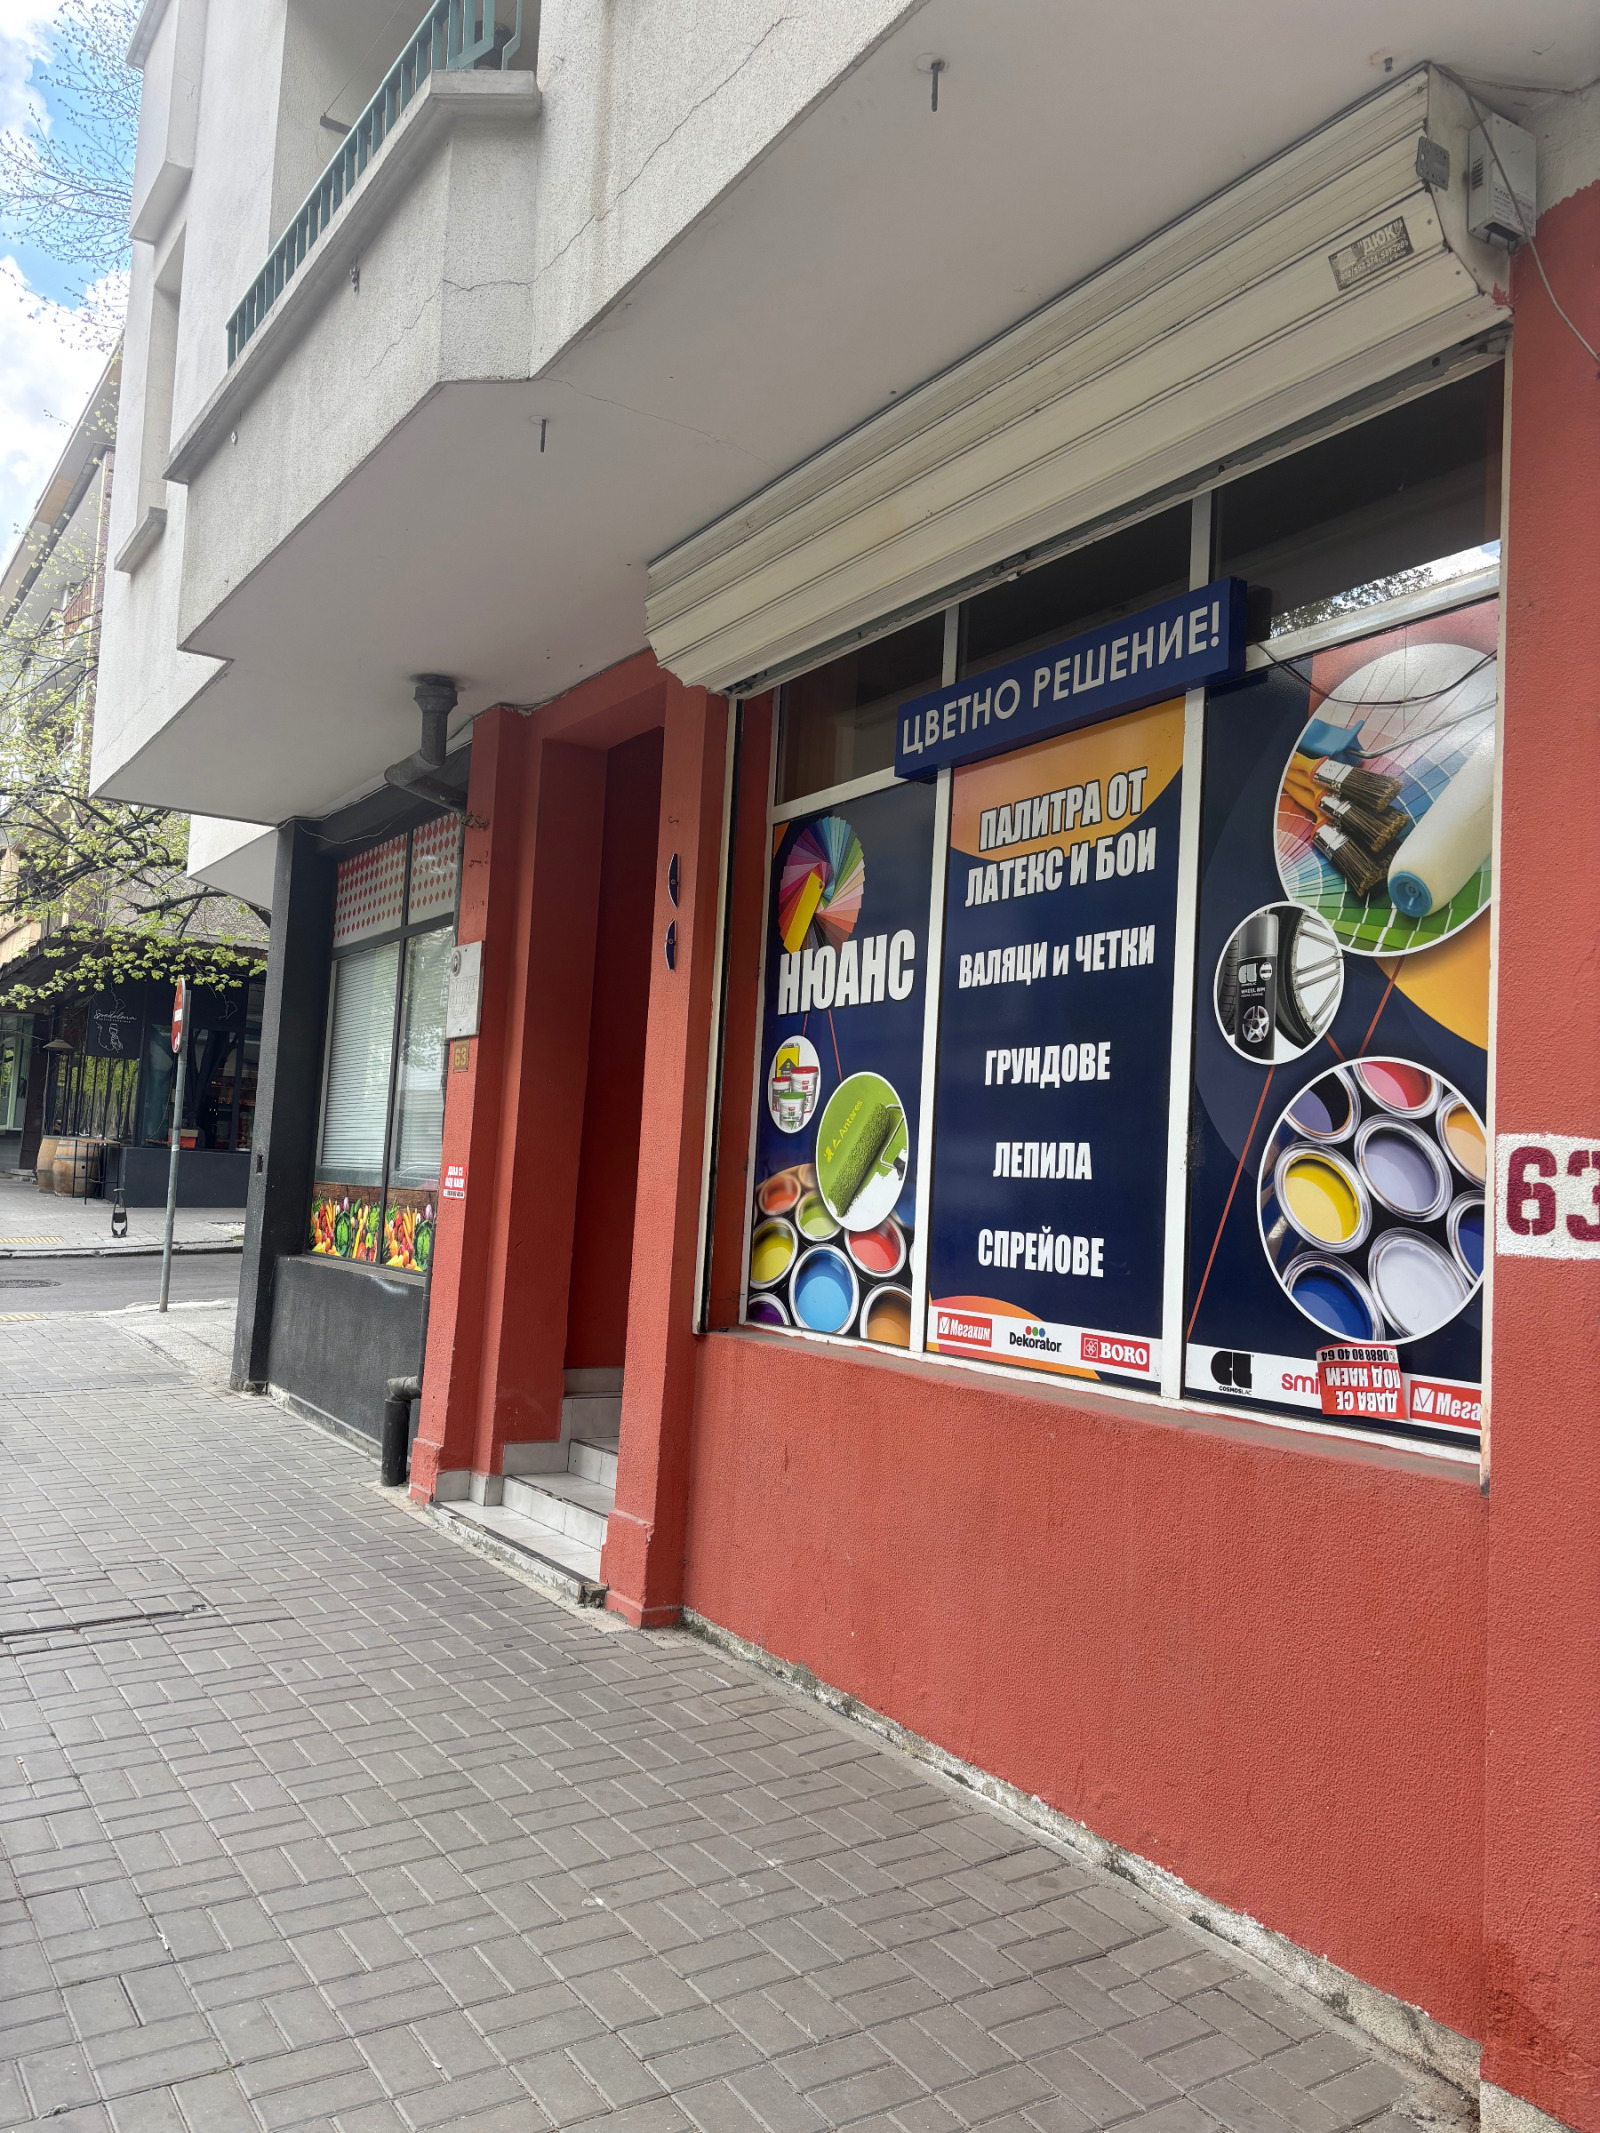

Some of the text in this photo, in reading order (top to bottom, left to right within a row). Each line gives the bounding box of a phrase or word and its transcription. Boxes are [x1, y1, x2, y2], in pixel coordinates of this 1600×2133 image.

[902, 601, 1220, 755] ЦВЕТНО РЕШЕНИЕ!
[980, 767, 1148, 852] ПАЛИТРА ОТ
[964, 827, 1157, 908] ЛАТЕКС И БОИ
[777, 929, 916, 1015] НЮАНС
[959, 941, 1048, 989] ВАЛЯЦИ
[1075, 924, 1156, 972] ЧЕТКИ
[455, 1048, 467, 1066] 63
[984, 1041, 1111, 1089] ГРУНДОВЕ
[839, 1100, 863, 1139] Antares
[993, 1142, 1093, 1180] ЛЕПИЛА
[978, 1225, 1105, 1278] СПРЕЙОВЕ
[950, 1319, 991, 1341] Мегахим
[1009, 1331, 1062, 1353] Dekorator
[1100, 1342, 1148, 1366] BORO
[1321, 1348, 1390, 1362] 0888 80 40 64
[1219, 1385, 1252, 1396] COSMOSLAC
[1325, 1365, 1401, 1389] ПОД НАЕМ
[1335, 1390, 1398, 1413] ДАВА СЕ
